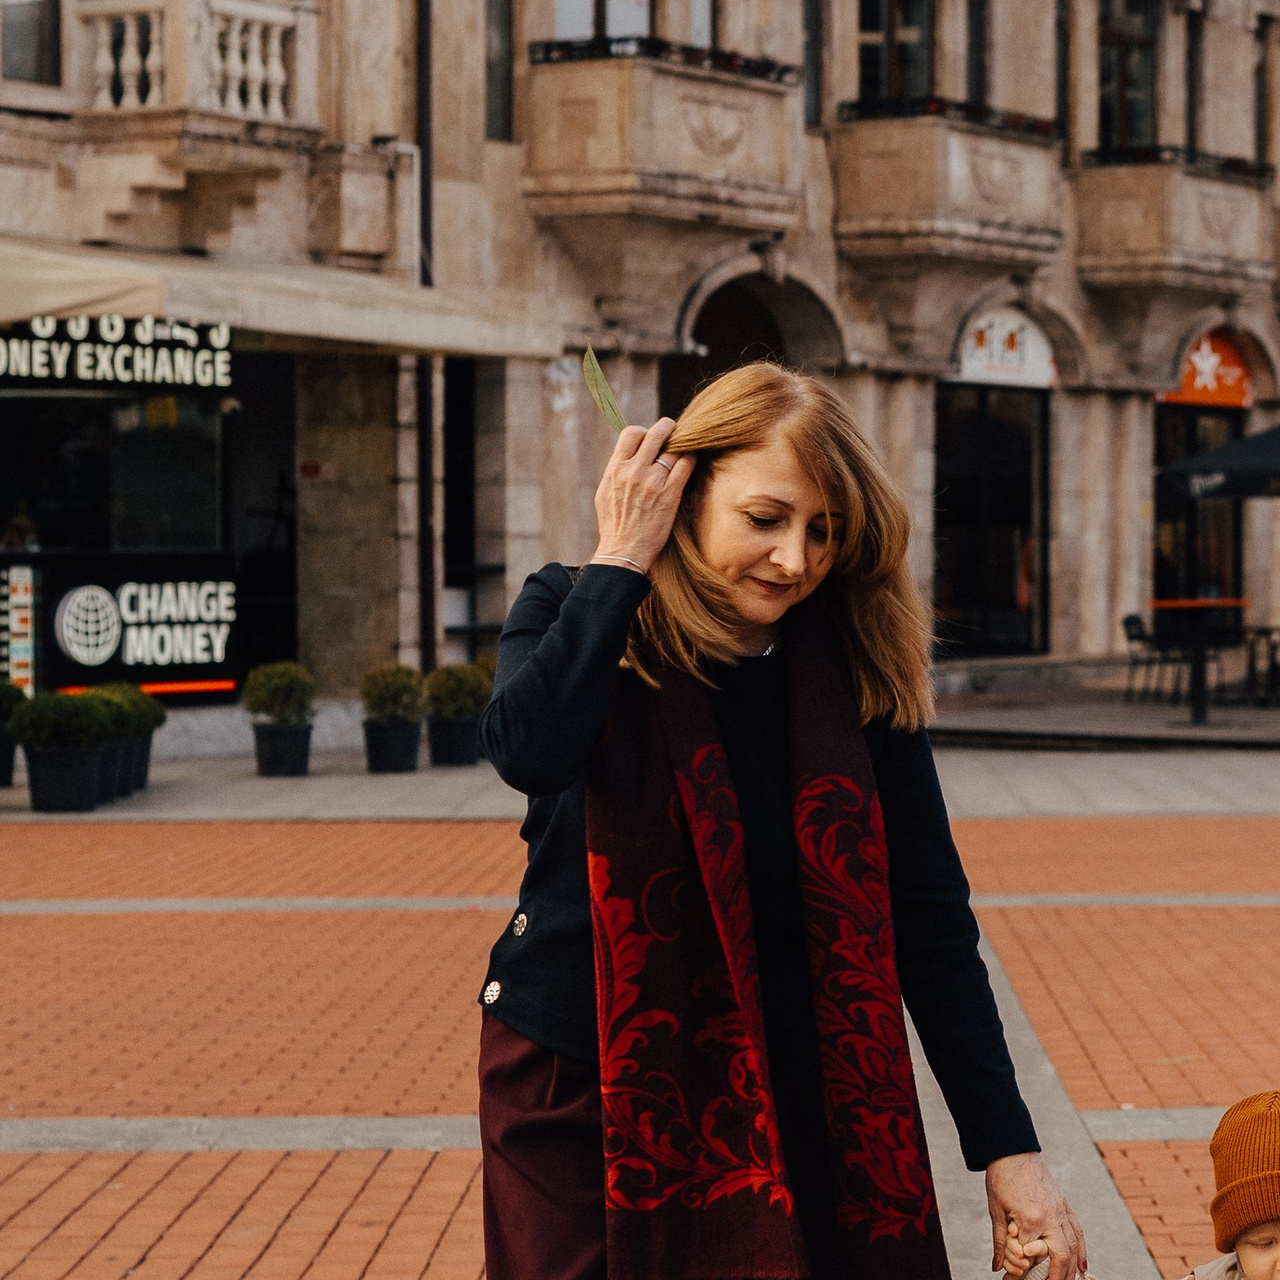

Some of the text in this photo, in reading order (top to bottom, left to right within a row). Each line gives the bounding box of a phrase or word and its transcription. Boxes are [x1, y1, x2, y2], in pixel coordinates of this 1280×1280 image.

[76, 342, 232, 387] EXCHANGE
[120, 581, 237, 624] CHANGE
[124, 622, 230, 665] MONEY
